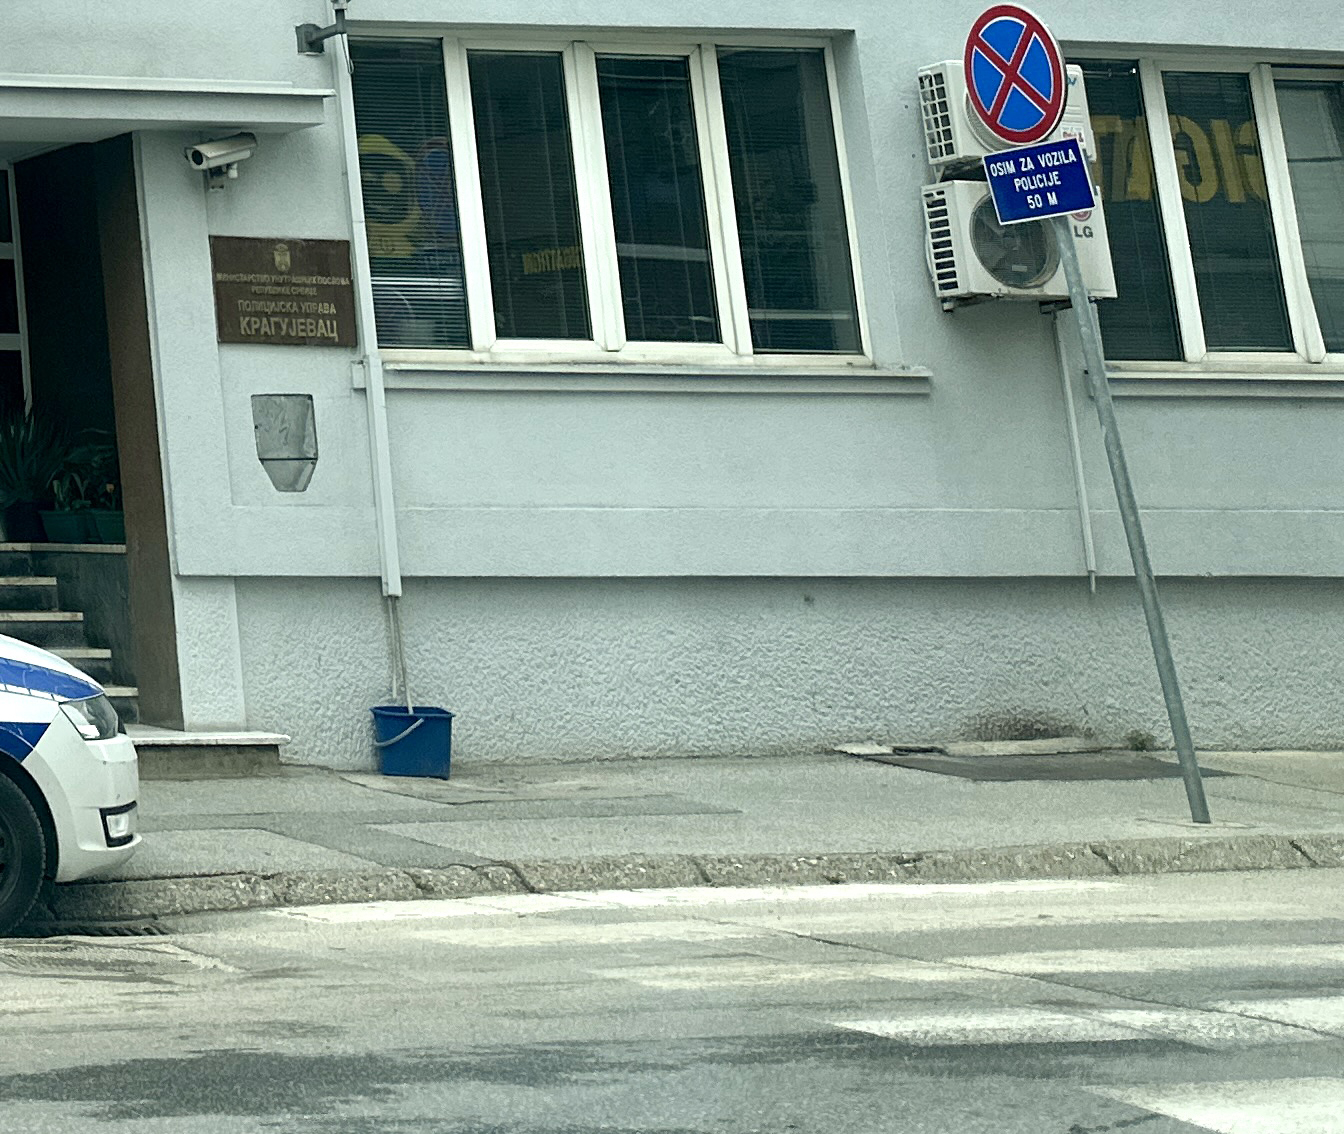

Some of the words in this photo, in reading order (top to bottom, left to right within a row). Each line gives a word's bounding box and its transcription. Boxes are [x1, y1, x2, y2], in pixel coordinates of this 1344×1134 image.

[990, 159, 1016, 177] OSIM
[1019, 156, 1035, 172] ZA
[1037, 148, 1077, 168] VOZILA
[1013, 171, 1062, 192] POLICIJE
[1026, 193, 1043, 209] 50
[1046, 191, 1058, 206] M
[1073, 225, 1094, 239] LG
[237, 299, 298, 314] ПОЛИЦИЈСКА
[301, 301, 337, 315] УПРАВА
[239, 316, 339, 343] КРАГУЈЕВАЦ
